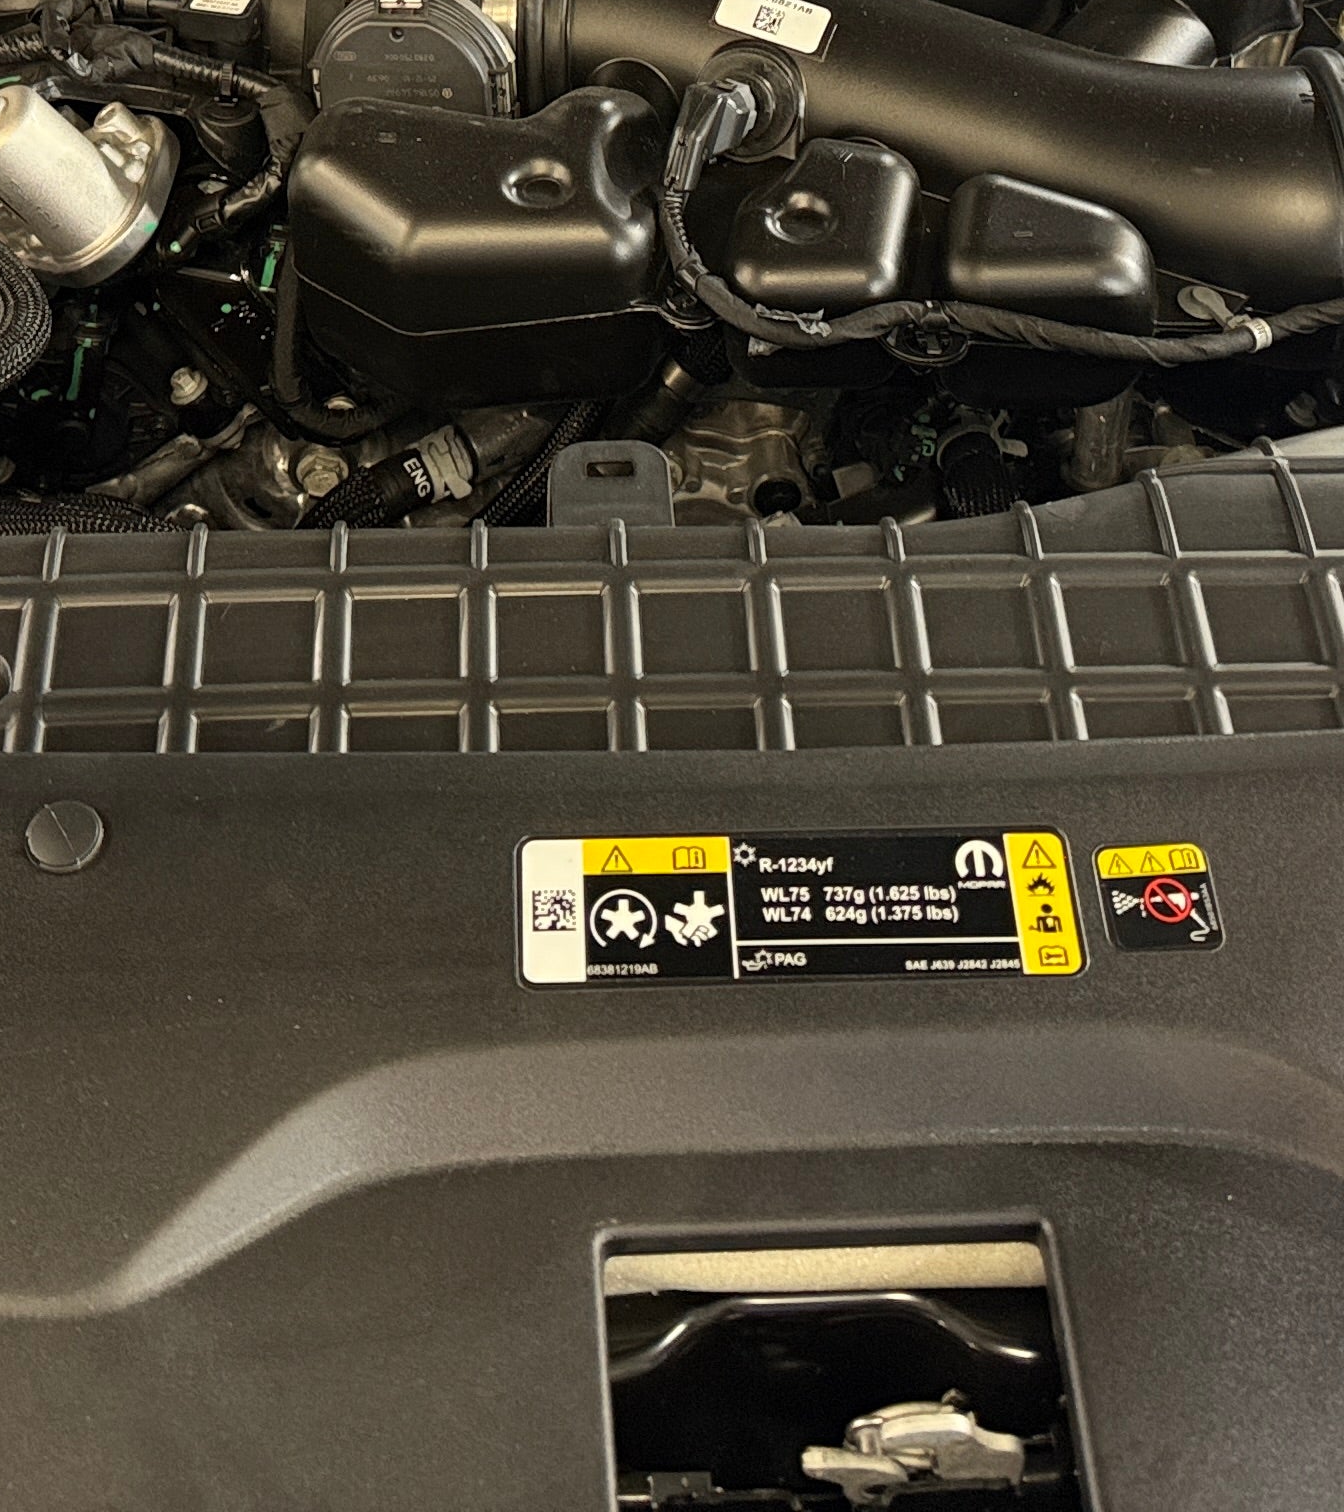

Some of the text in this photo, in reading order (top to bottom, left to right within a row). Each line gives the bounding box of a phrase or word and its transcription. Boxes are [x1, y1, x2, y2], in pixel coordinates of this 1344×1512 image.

[402, 457, 431, 498] ENG
[758, 856, 834, 876] R-1234yf
[760, 885, 956, 905] WL75 737g (1.625 lbs)
[762, 905, 959, 925] WL74 624g (1.375 lbs)
[774, 951, 807, 966] PAG
[904, 959, 928, 970] SAE
[930, 959, 956, 970] J639
